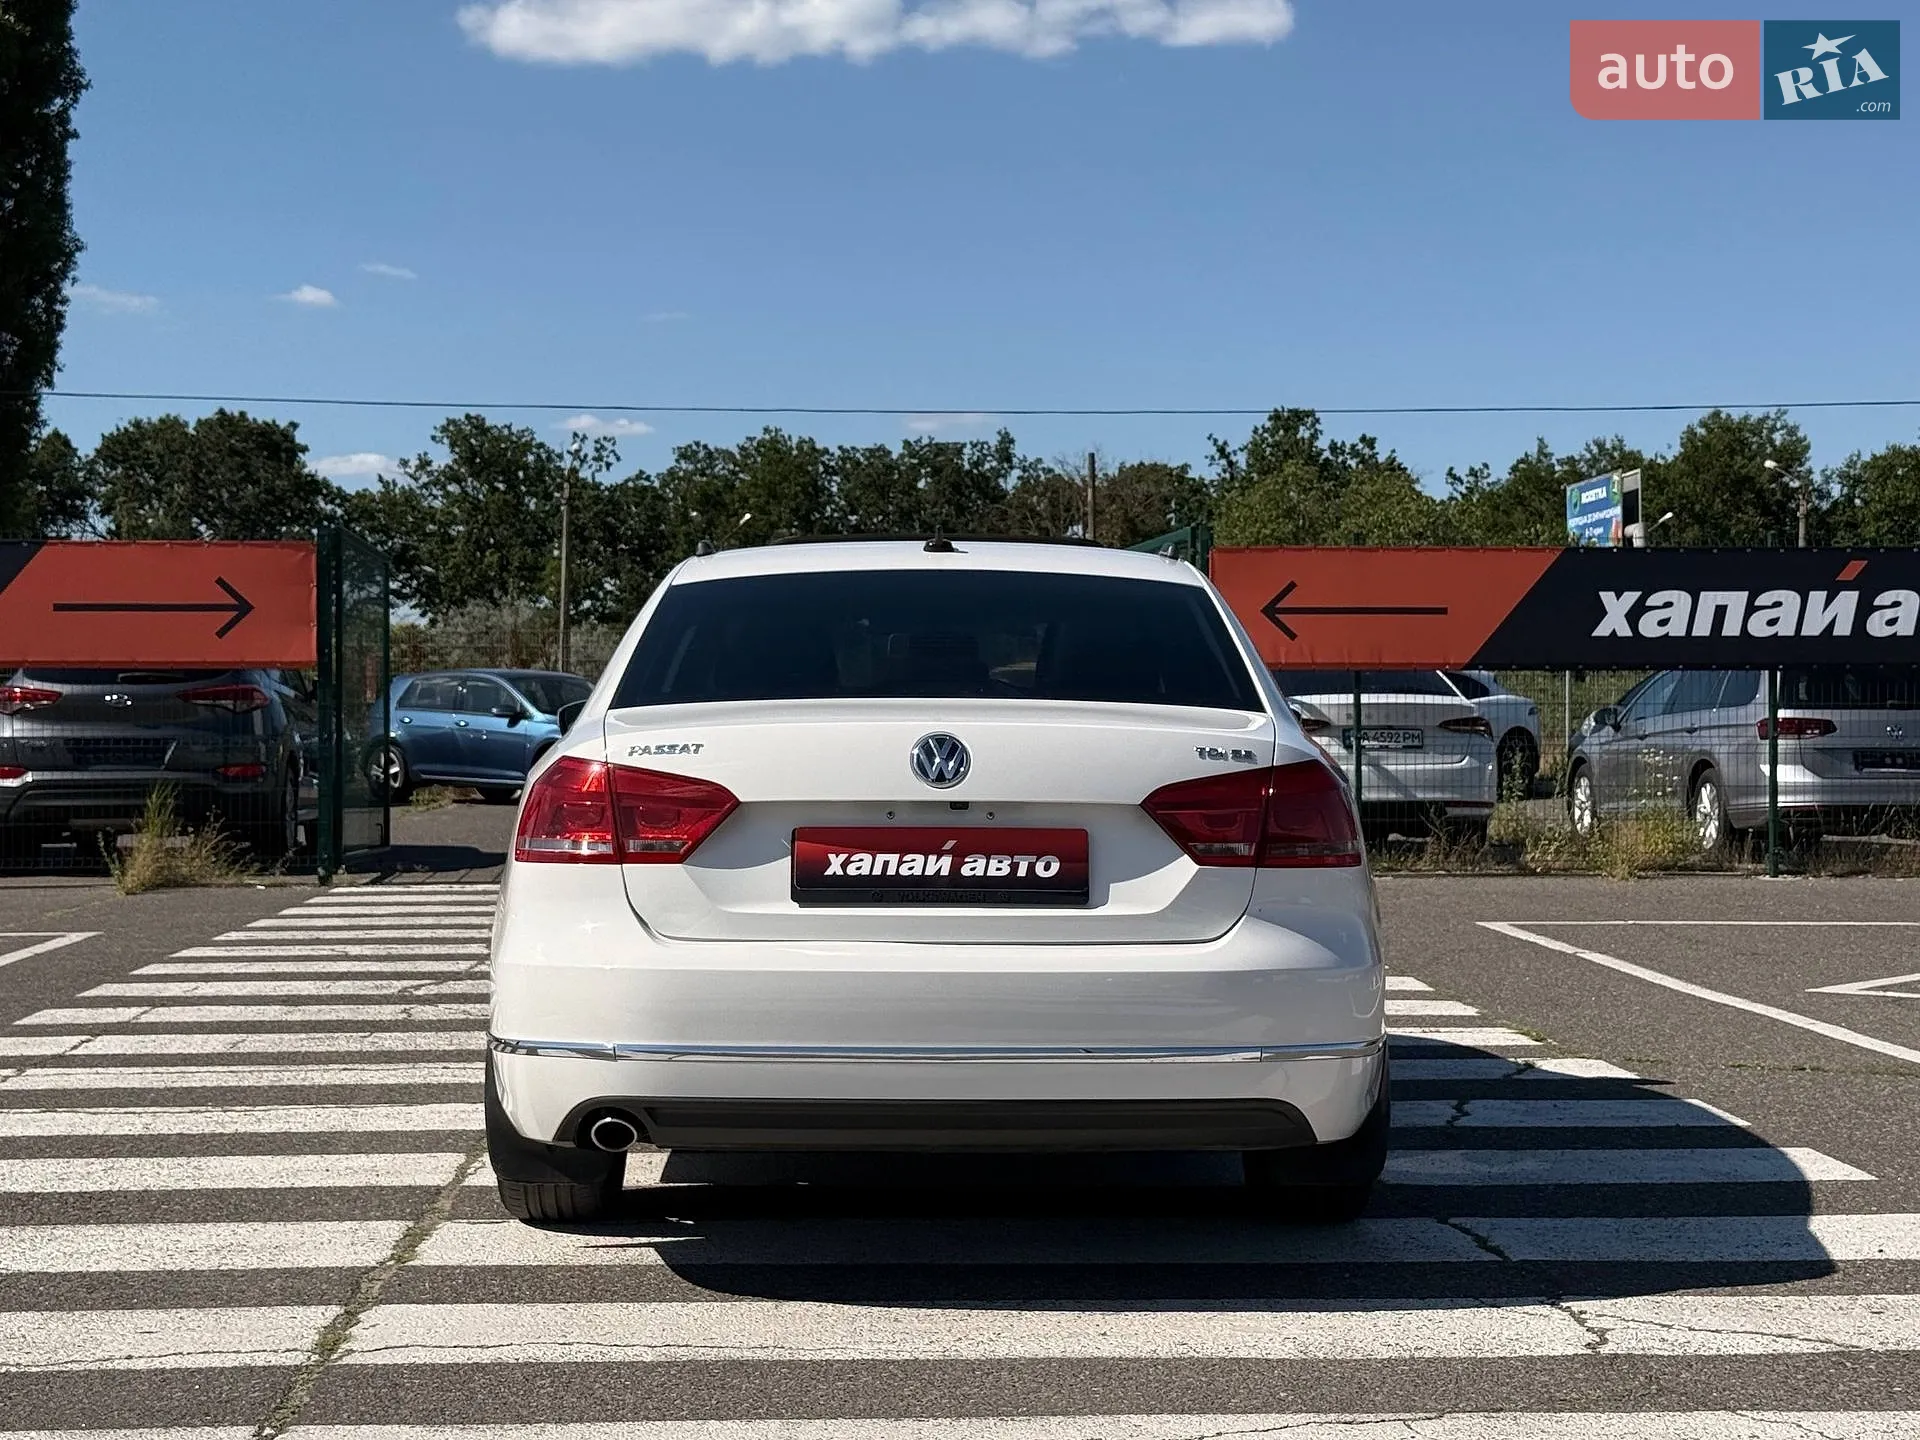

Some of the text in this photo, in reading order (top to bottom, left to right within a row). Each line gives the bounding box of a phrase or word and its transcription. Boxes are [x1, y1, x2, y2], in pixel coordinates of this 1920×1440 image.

[1591, 560, 1868, 638] хапай
[628, 743, 704, 757] PASSAT
[824, 840, 1060, 878] хапай авто
